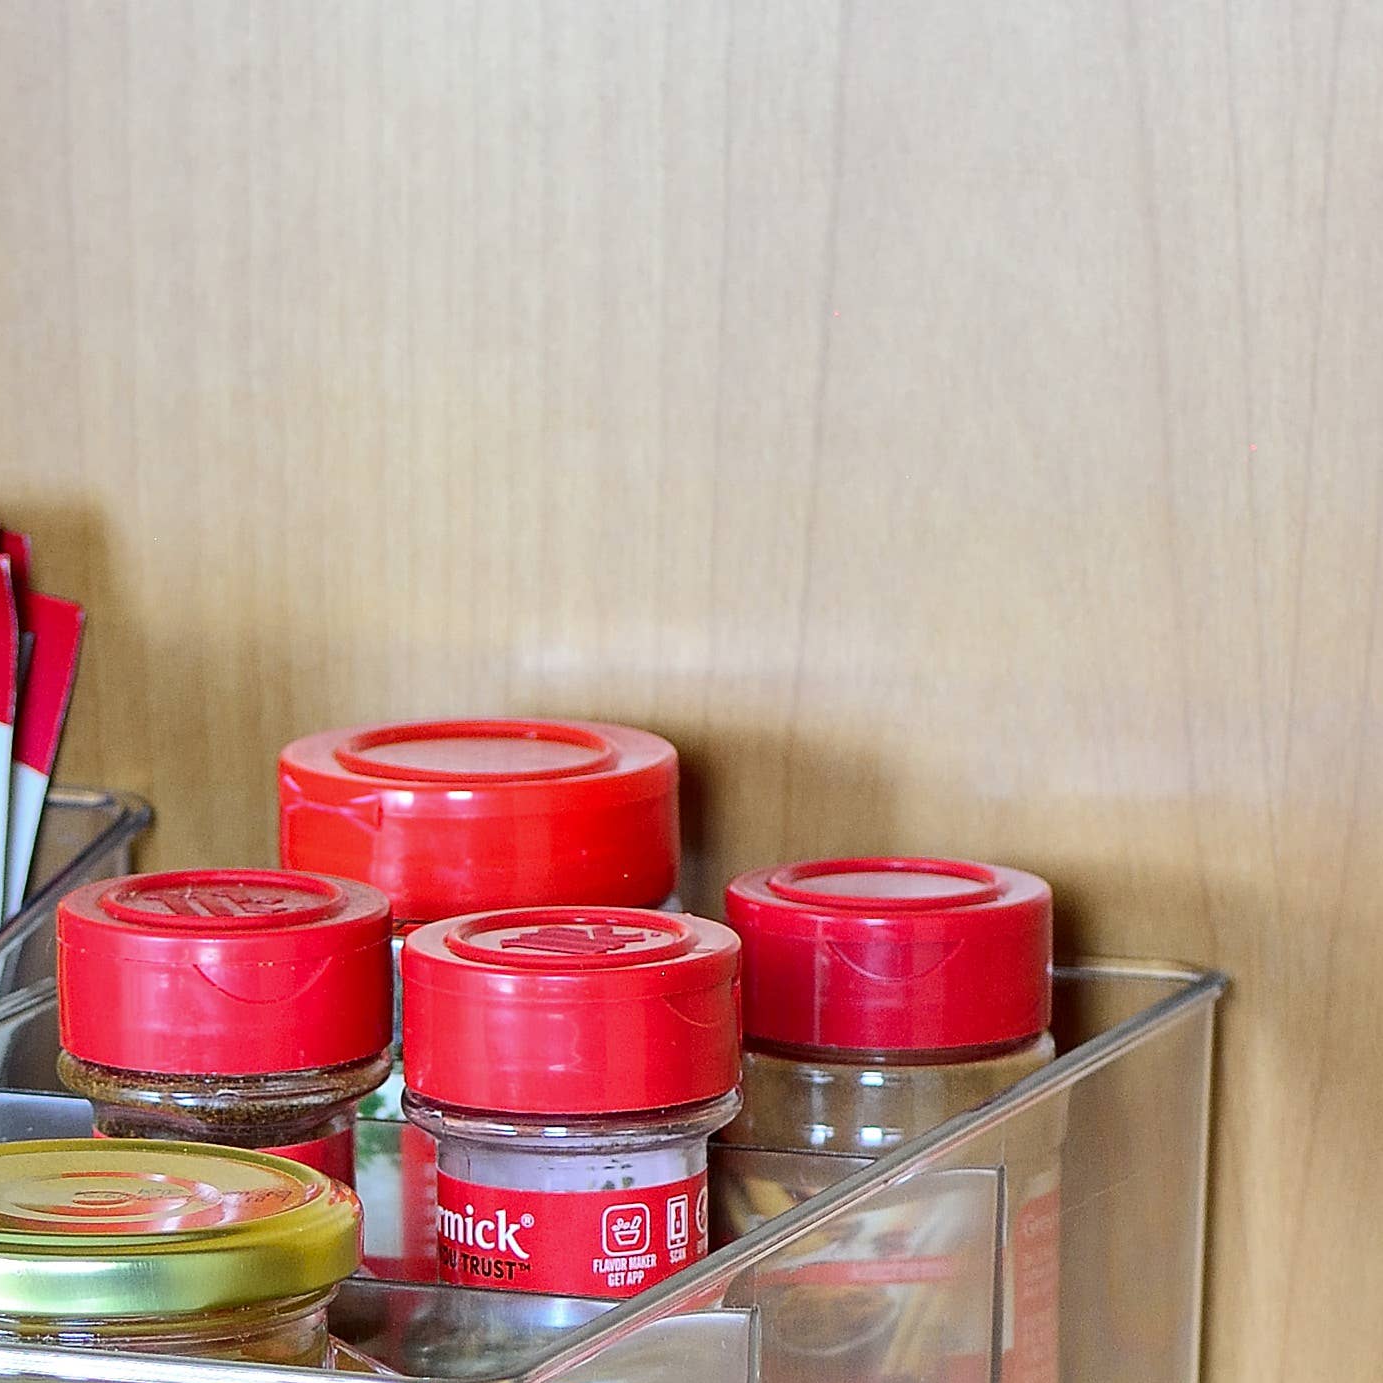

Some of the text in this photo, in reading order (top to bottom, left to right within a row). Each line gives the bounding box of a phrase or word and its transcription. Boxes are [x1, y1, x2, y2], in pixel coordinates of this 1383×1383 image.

[593, 1258, 627, 1273] FLAVOR
[607, 1270, 645, 1287] GET APP
